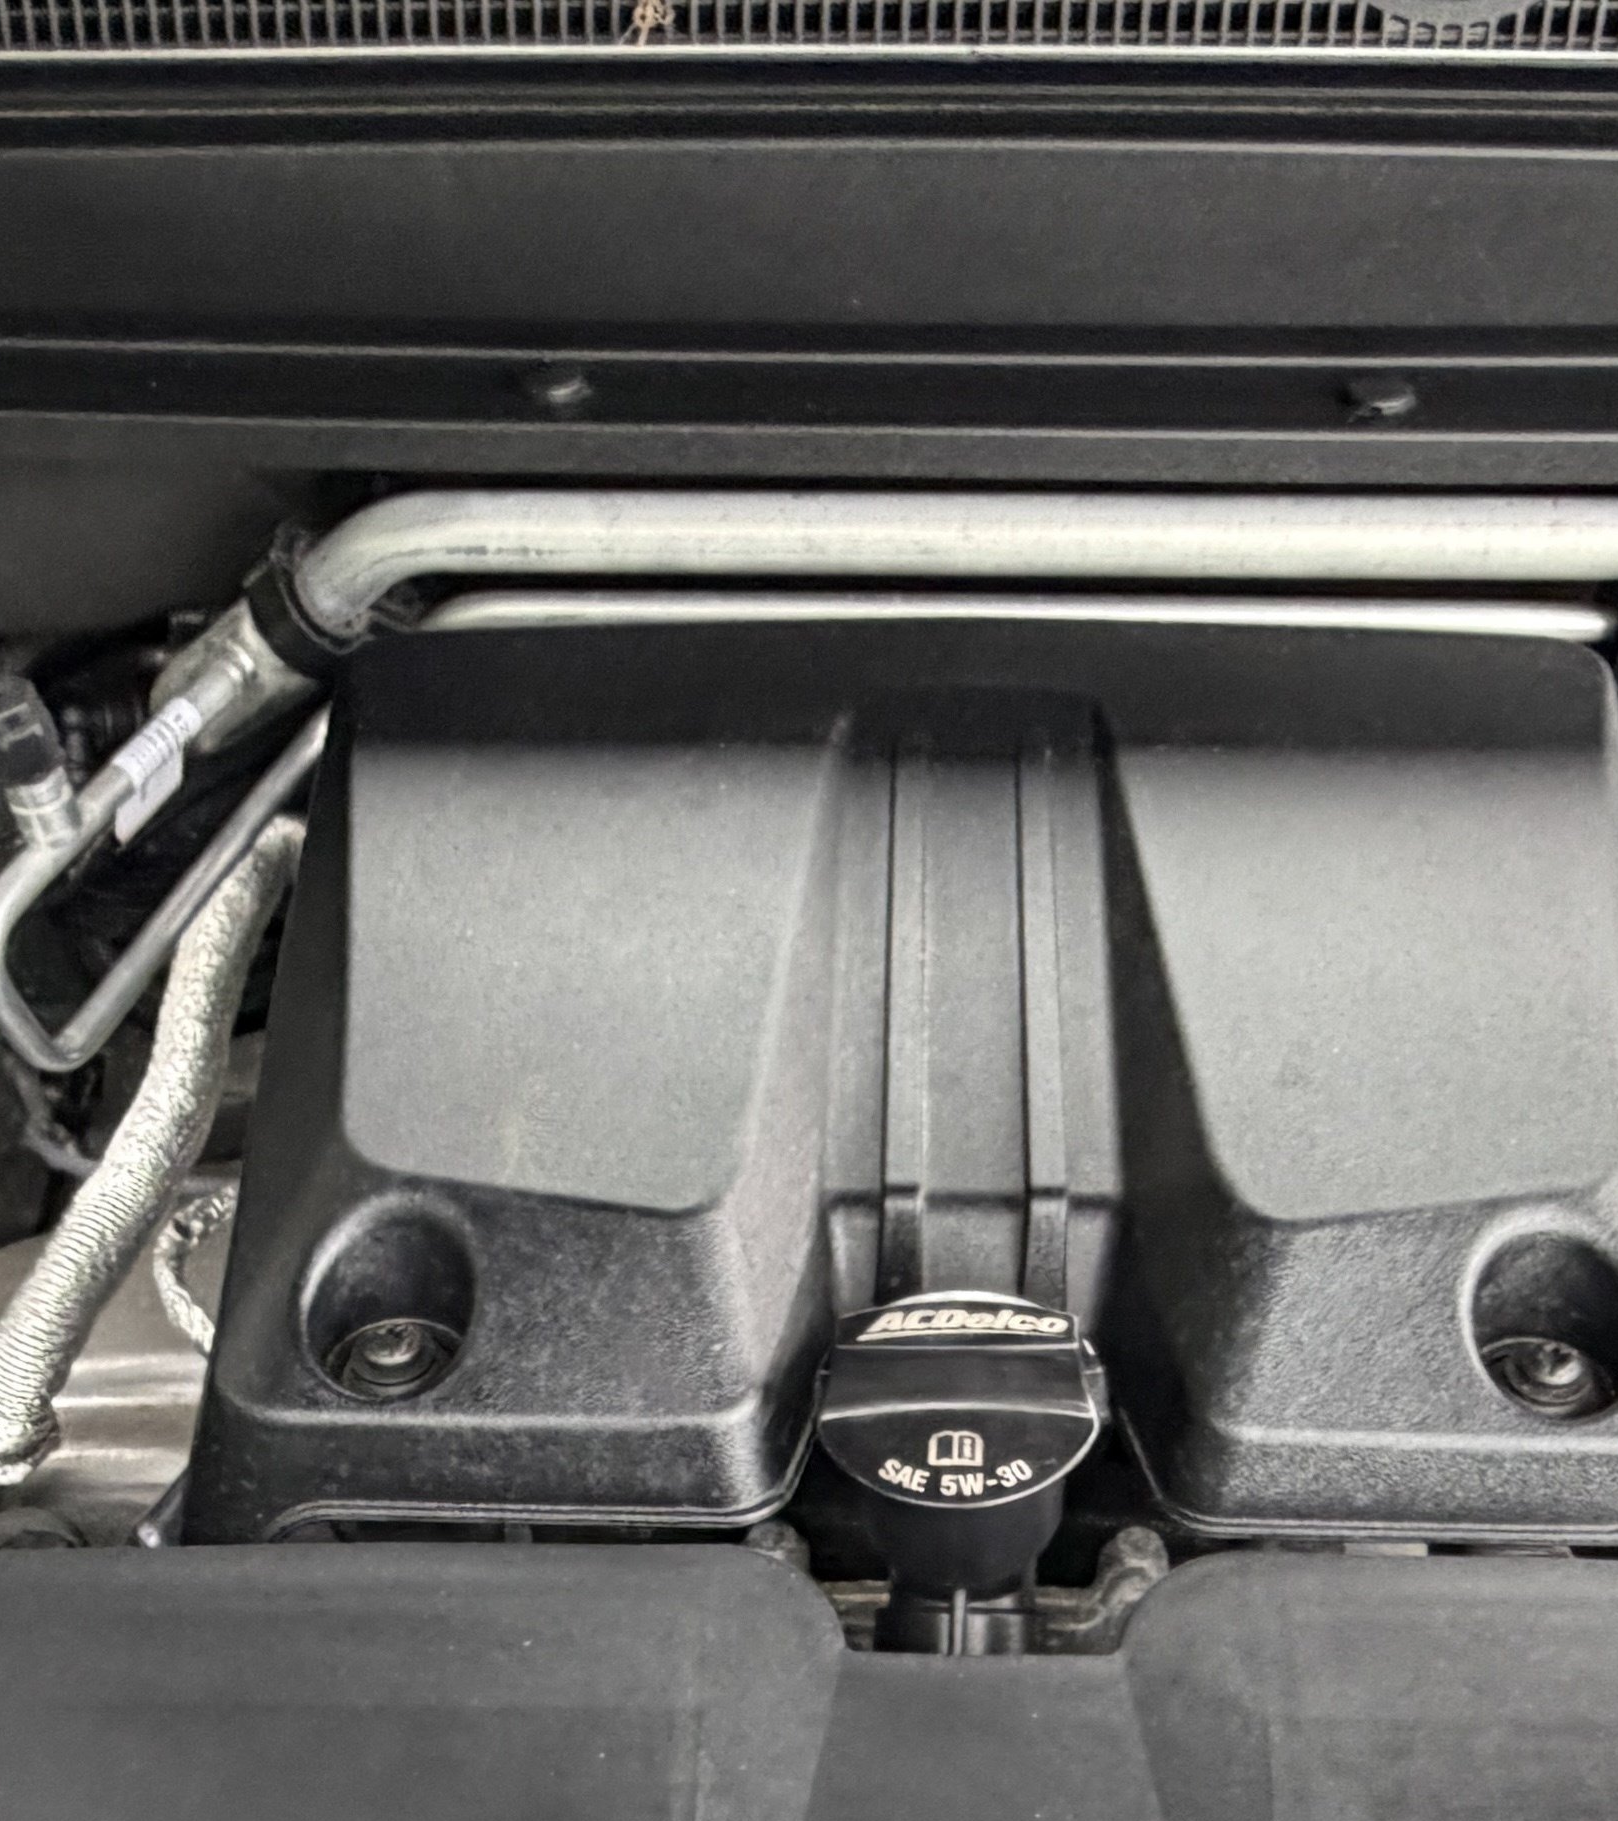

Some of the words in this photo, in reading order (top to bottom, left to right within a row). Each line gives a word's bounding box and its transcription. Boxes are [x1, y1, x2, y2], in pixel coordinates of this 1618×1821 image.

[863, 1308, 1069, 1336] ACDelco
[878, 1458, 930, 1493] SAE
[939, 1458, 1033, 1497] 5W-30
